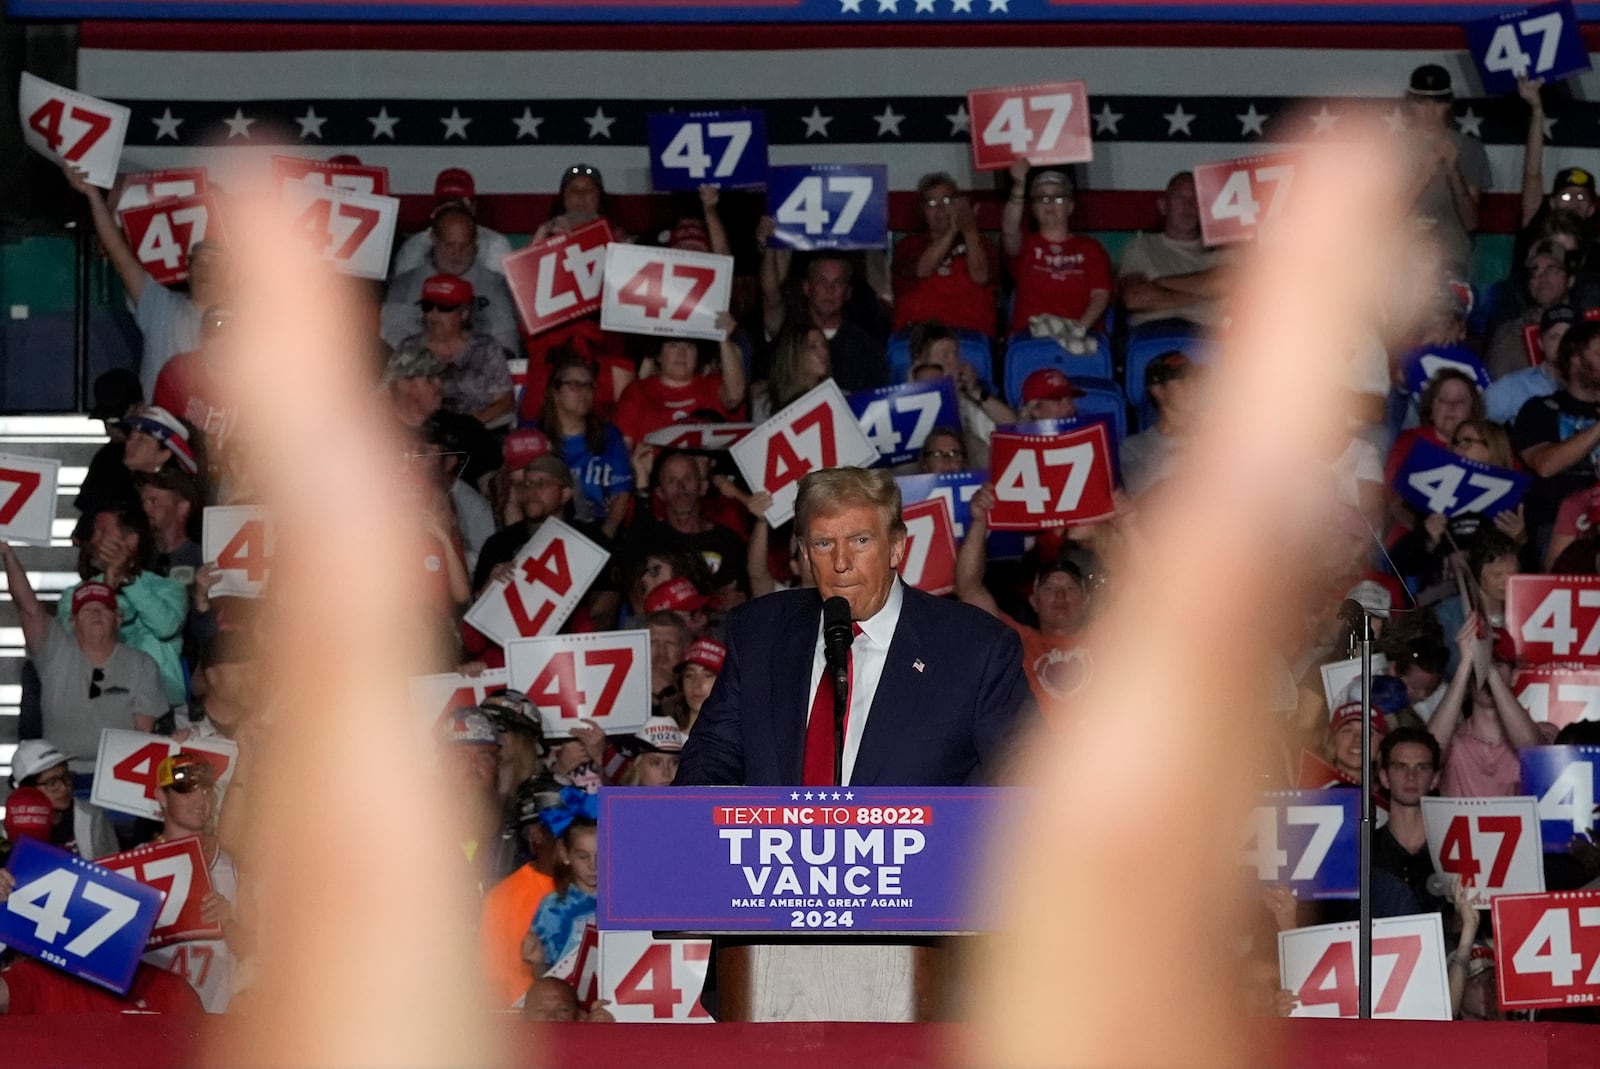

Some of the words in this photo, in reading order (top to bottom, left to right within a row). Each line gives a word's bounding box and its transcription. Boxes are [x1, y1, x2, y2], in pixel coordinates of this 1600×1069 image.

[1484, 11, 1564, 77] 47
[28, 97, 112, 163] 47
[660, 120, 753, 179] 47
[983, 93, 1074, 153] 47
[776, 175, 873, 235] 47
[1211, 164, 1297, 226] 47
[137, 204, 209, 269] 47
[292, 198, 381, 260] 47
[534, 243, 606, 319] 47
[617, 261, 716, 321] 47
[764, 401, 838, 495] 47
[857, 391, 942, 454] 47
[994, 442, 1094, 514] 47
[1408, 463, 1515, 518] 47
[216, 519, 274, 582] 4
[898, 514, 935, 588] 7
[503, 537, 573, 637] 47
[524, 647, 634, 719] 47
[719, 829, 926, 865] TRUMP
[721, 807, 776, 824] TEXT
[783, 807, 814, 824] NC
[820, 807, 849, 824] TO
[856, 807, 924, 824] 88022
[1240, 805, 1345, 881] 47
[742, 866, 902, 895] VANCE
[1439, 815, 1523, 888] 47
[7, 868, 141, 958] 47
[115, 853, 194, 929] 7
[731, 899, 766, 908] MAKE
[769, 899, 823, 908] AMERICA
[828, 899, 867, 908] GREAT
[871, 899, 913, 908] AGAIN!
[790, 910, 854, 928] 2024
[40, 949, 67, 968] 2024
[168, 945, 213, 988] 47
[1298, 934, 1423, 1018] 47
[1566, 994, 1594, 1003] 2024
